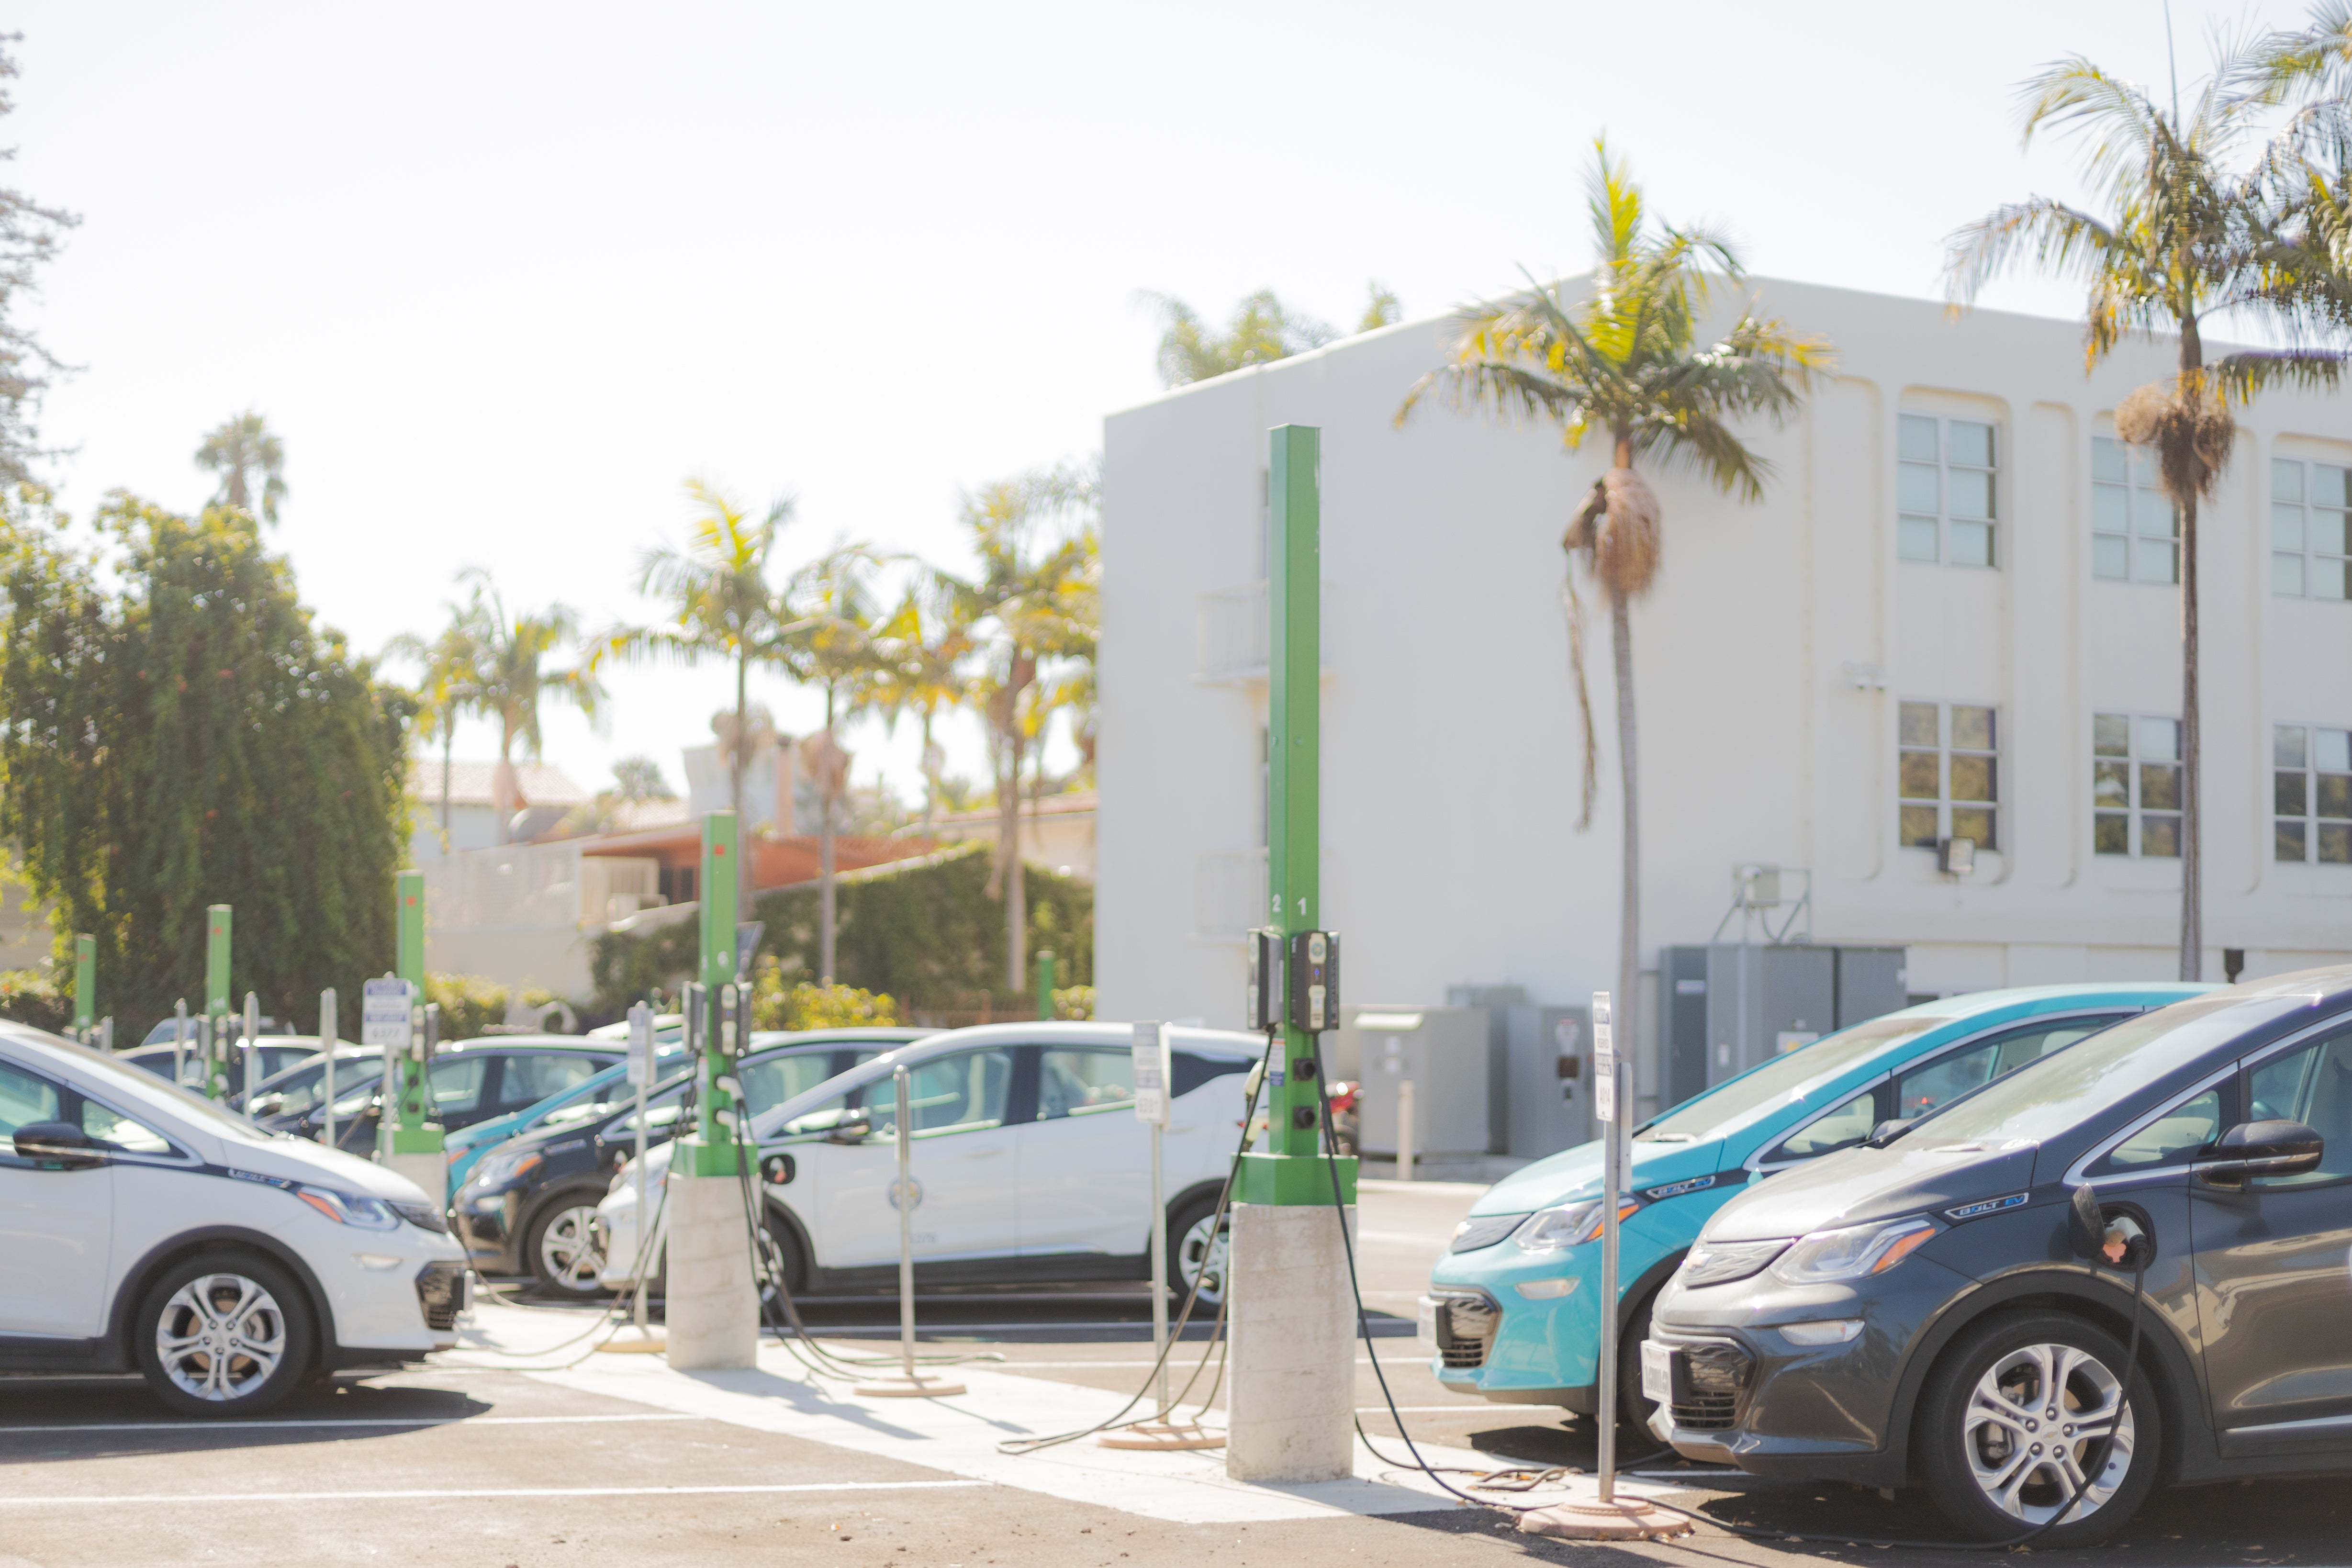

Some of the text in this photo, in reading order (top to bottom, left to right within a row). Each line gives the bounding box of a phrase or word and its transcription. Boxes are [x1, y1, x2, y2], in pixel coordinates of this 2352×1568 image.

[1272, 894, 1282, 912] 2
[1298, 897, 1307, 915] 1
[1959, 1196, 2025, 1216] BOLT EV
